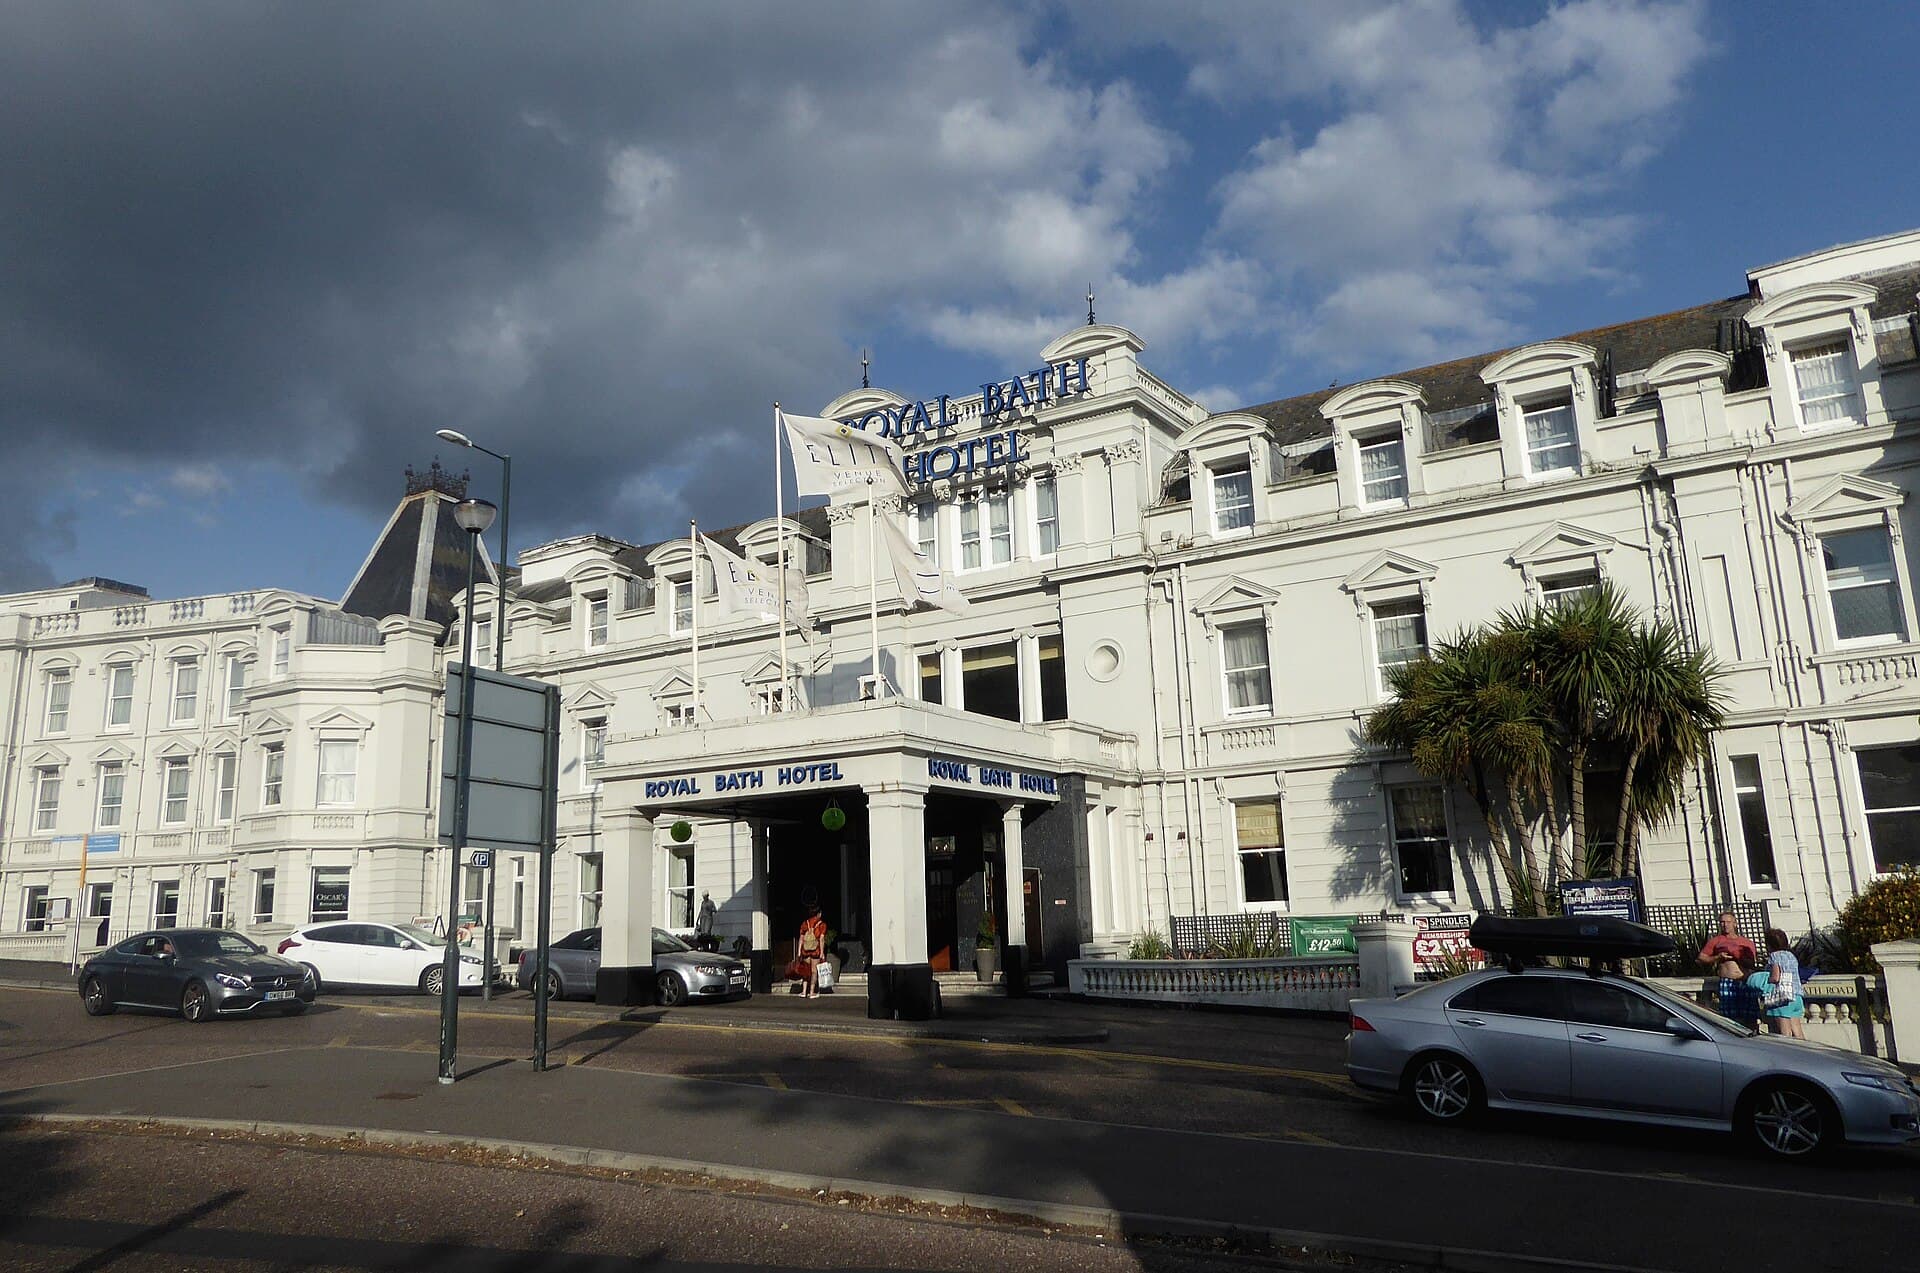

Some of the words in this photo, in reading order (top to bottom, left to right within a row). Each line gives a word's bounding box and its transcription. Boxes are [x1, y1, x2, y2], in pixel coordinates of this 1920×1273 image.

[980, 358, 1090, 417] BATH
[806, 443, 895, 466] ELITE
[902, 429, 1029, 484] HOTEL
[833, 469, 882, 480] VENUE
[645, 778, 700, 798] ROYAL
[715, 770, 763, 792] BATH
[778, 762, 843, 786] HOTEL
[928, 759, 972, 783] ROYAL
[980, 767, 1012, 789] BATH
[1019, 773, 1057, 795] HOTEL
[479, 854, 487, 865] P
[1429, 916, 1469, 926] SPINDLES
[1309, 938, 1342, 952] £12.50
[1803, 986, 1822, 995] ATH
[1826, 986, 1855, 995] ROAD
